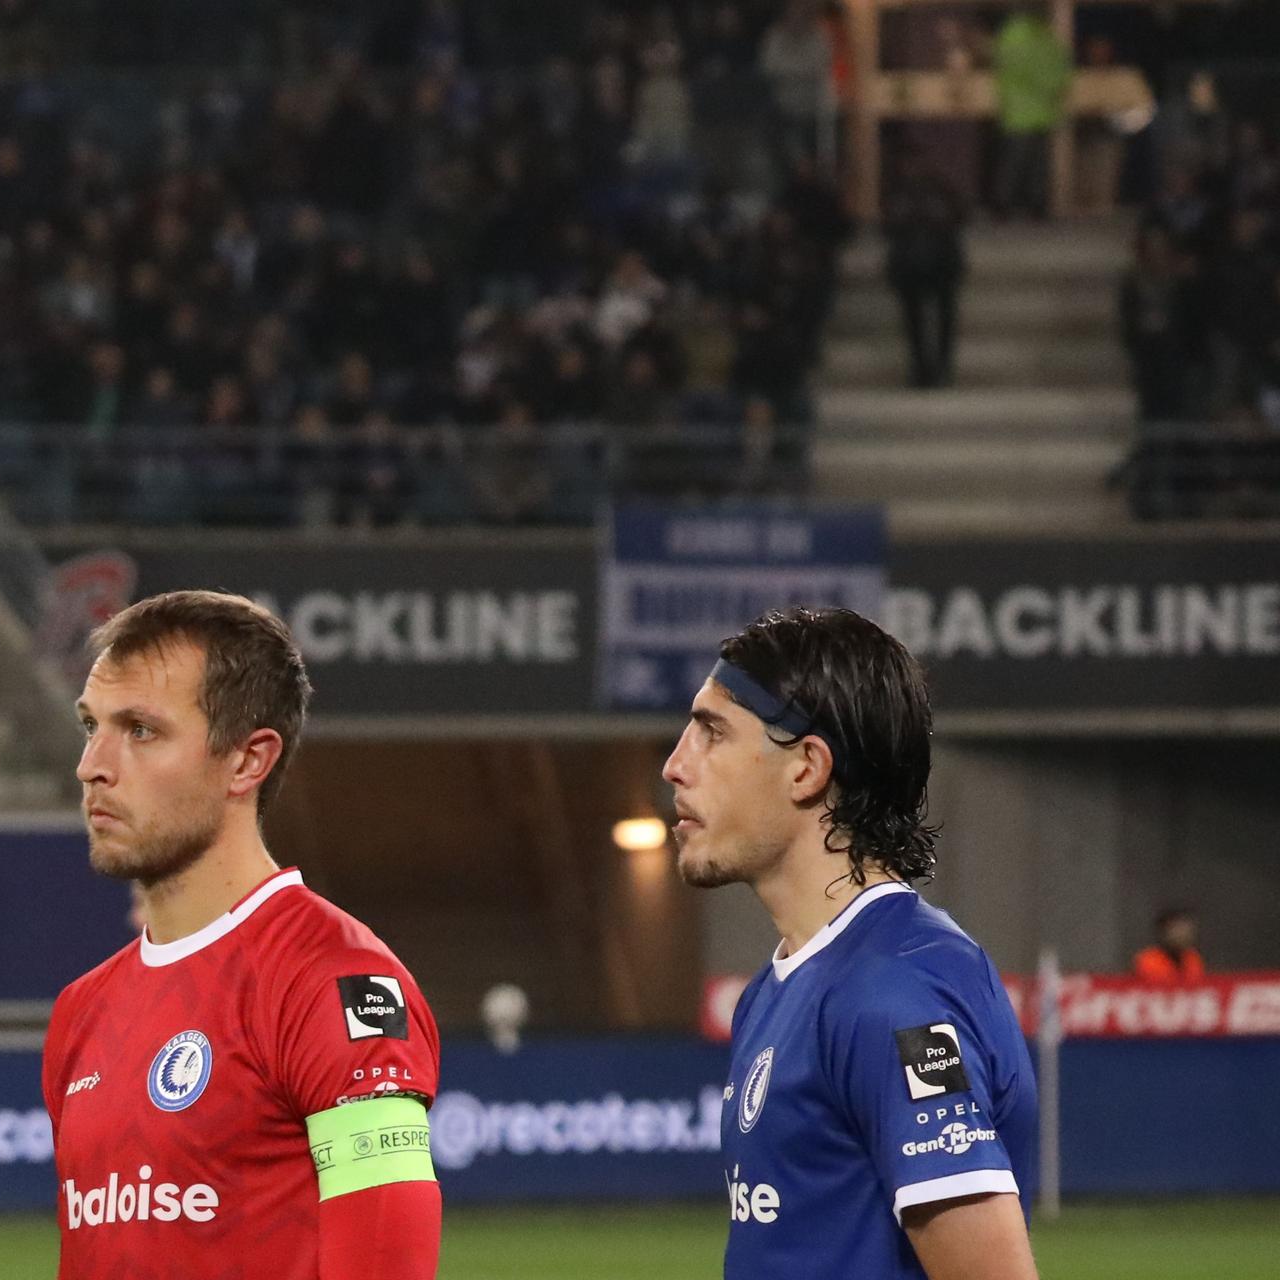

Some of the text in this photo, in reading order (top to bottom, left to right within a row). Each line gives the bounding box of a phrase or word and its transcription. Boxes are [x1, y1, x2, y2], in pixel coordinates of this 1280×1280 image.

[248, 588, 580, 663] CKLINE
[365, 993, 384, 1003] Pro
[357, 1005, 396, 1016] League
[926, 1047, 946, 1058] Pro
[353, 1066, 412, 1080] OPEL
[918, 1056, 960, 1073] League
[916, 1101, 980, 1124] OPEL
[902, 1135, 946, 1156] Gent
[65, 1165, 219, 1230] baloise
